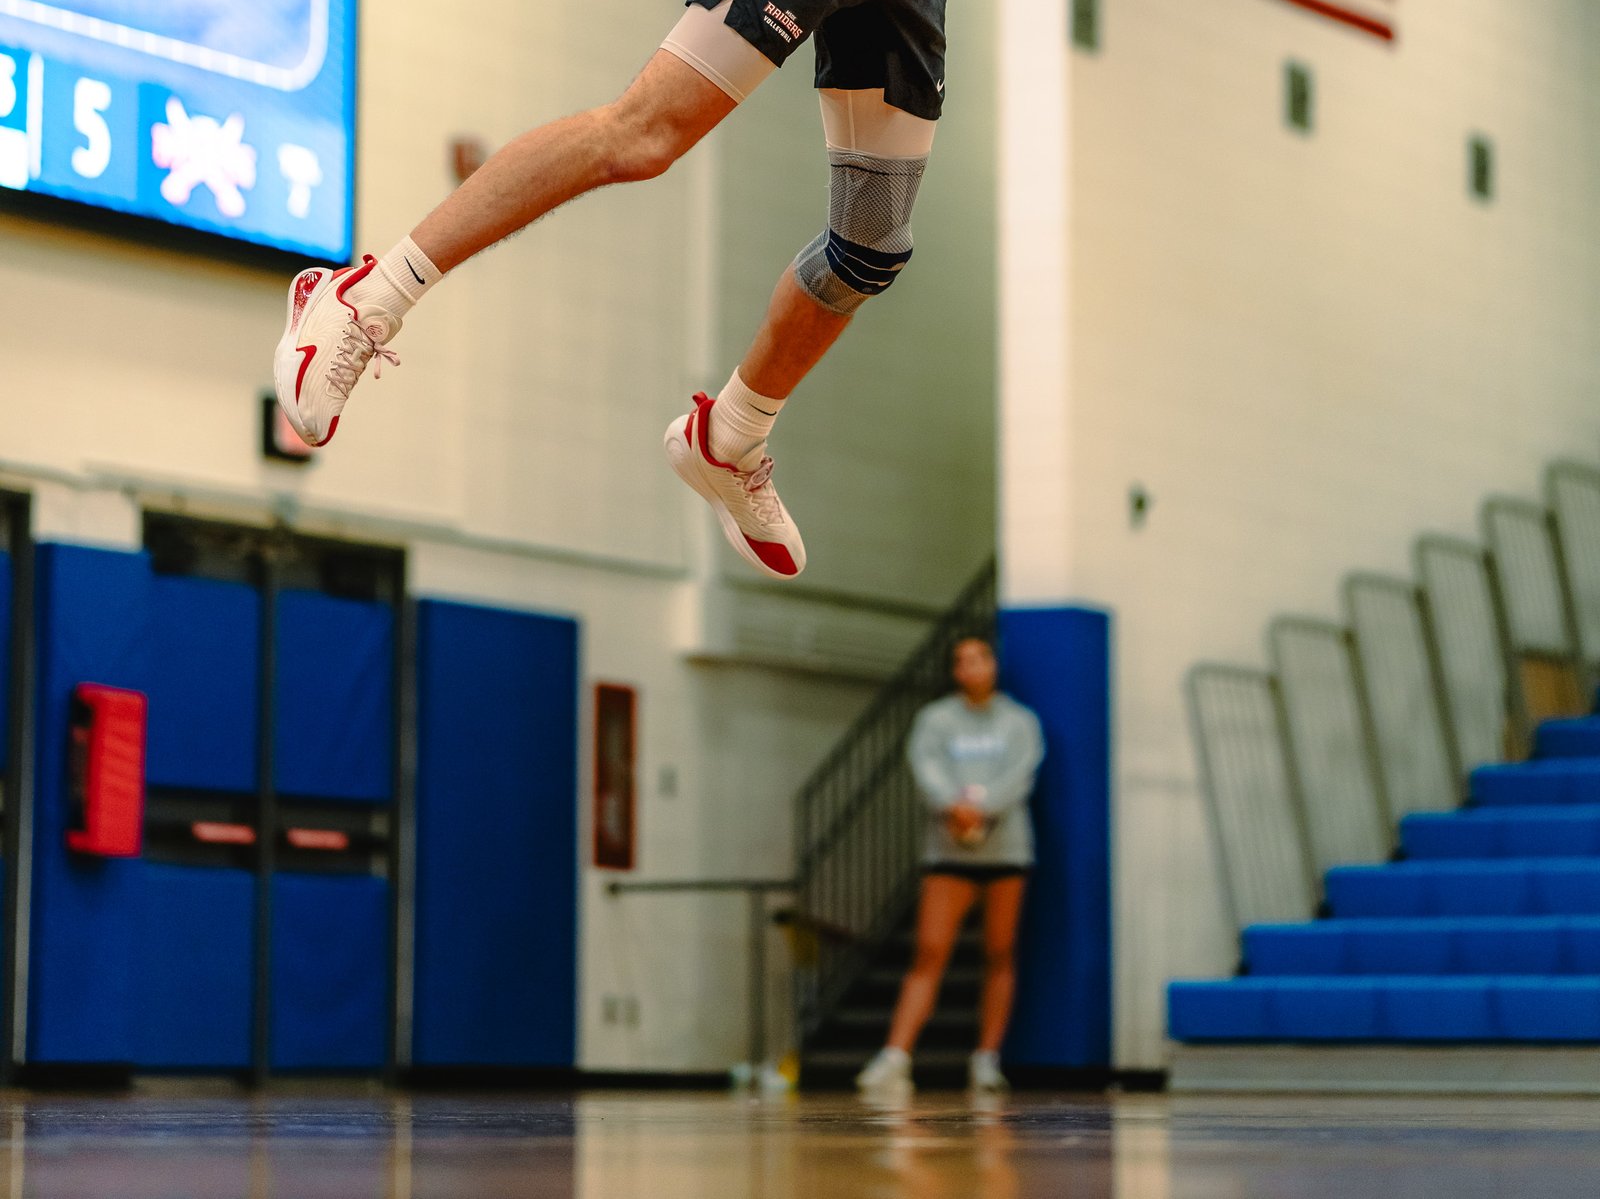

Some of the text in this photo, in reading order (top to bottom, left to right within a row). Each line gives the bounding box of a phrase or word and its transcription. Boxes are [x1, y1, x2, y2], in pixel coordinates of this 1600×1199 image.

[763, 0, 803, 40] RAIDERS
[763, 15, 792, 43] VOLLEYBALL
[71, 77, 112, 179] 5
